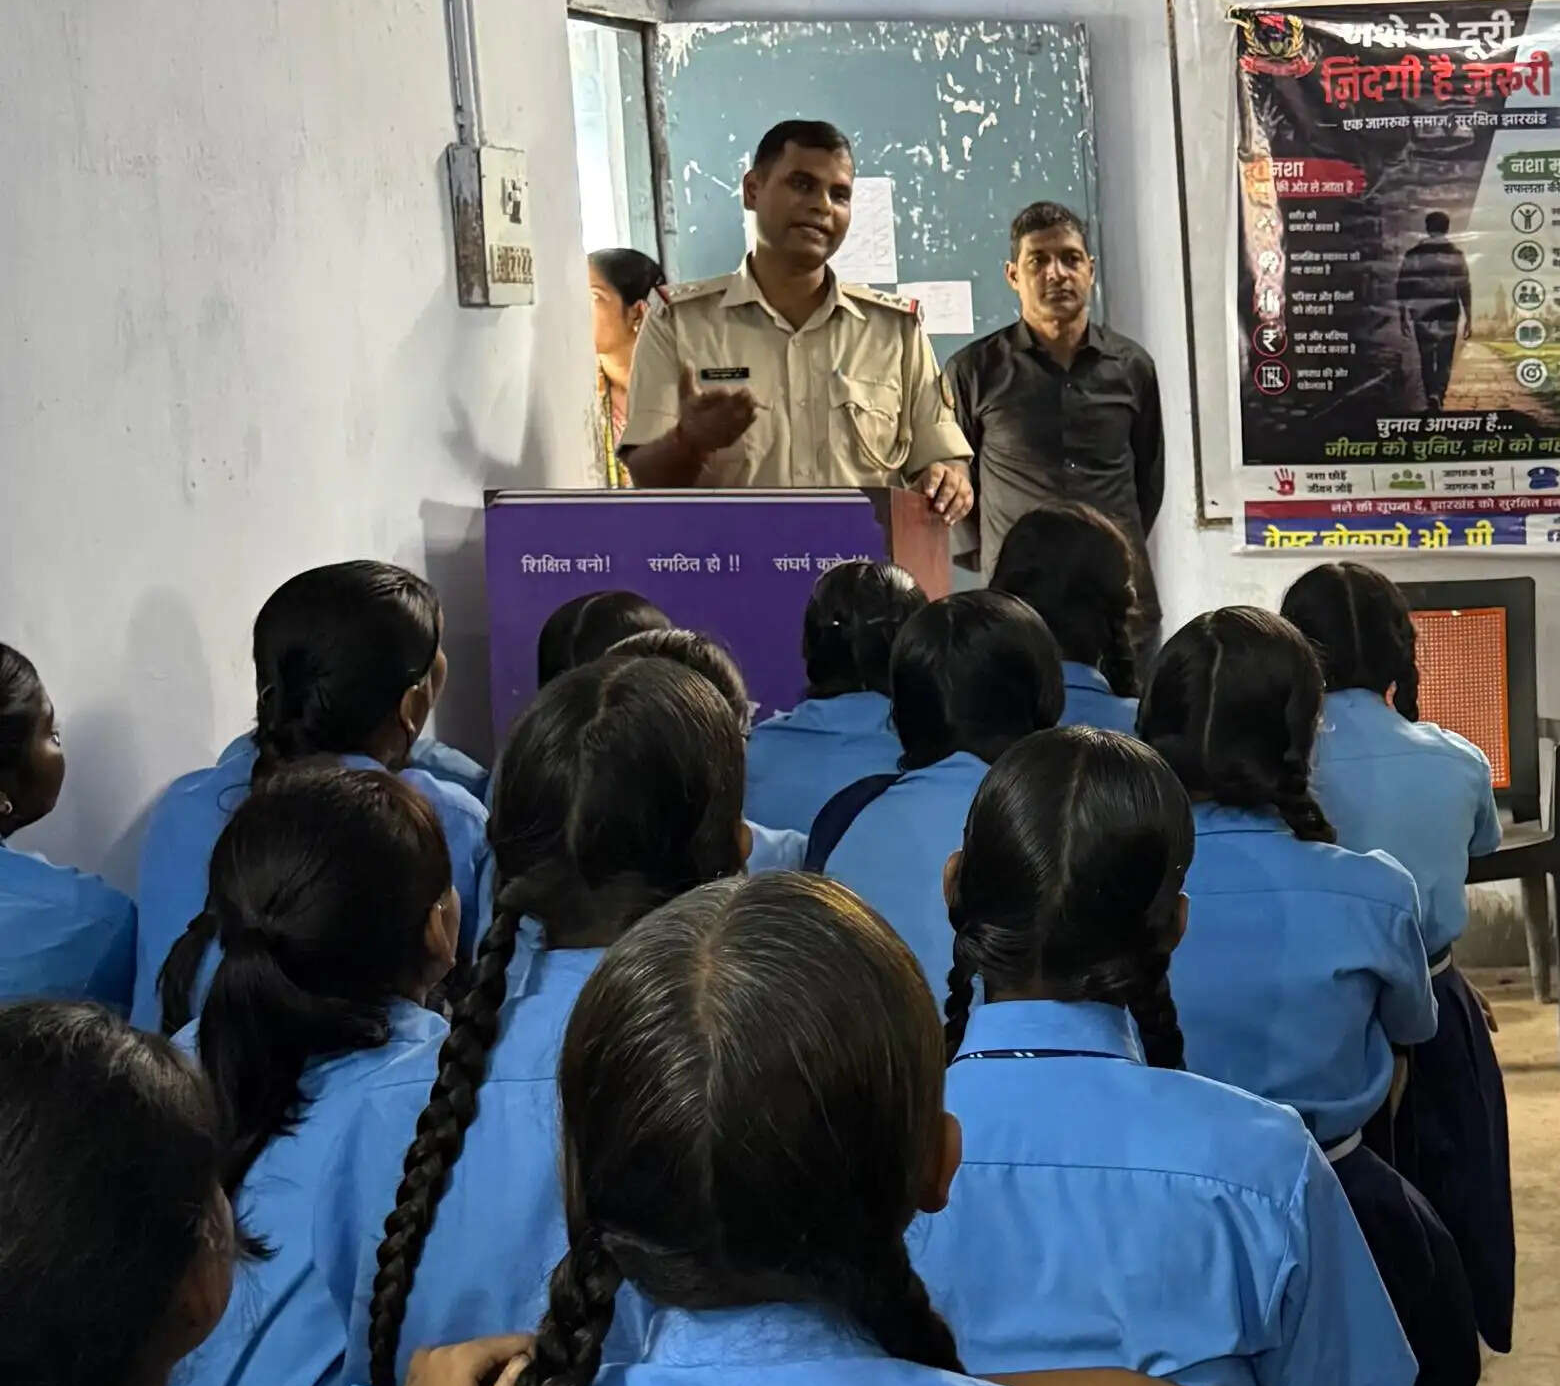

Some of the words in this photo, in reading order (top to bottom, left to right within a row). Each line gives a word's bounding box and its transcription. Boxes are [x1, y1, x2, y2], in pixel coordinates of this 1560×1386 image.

[1428, 53, 1455, 101] है
[1343, 119, 1363, 131] एक
[1455, 112, 1498, 131] सुरक्षित
[1501, 111, 1547, 126] झारखंड
[1271, 161, 1304, 177] नशा
[1509, 158, 1545, 174] नशा
[1346, 180, 1354, 193] है
[1504, 182, 1546, 195] सफलता
[1376, 418, 1421, 438] चुनाव
[1425, 417, 1482, 432] आपका
[1324, 437, 1376, 458] जीवन
[1382, 437, 1407, 456] को
[1412, 436, 1467, 460] चुनिए,
[1473, 435, 1503, 455] नशे
[1509, 434, 1535, 453] को
[1478, 497, 1494, 510] को
[521, 554, 571, 573] शिक्षित
[648, 553, 700, 573] संगठित
[705, 553, 720, 573] हो
[773, 553, 811, 572] संघर्ष
